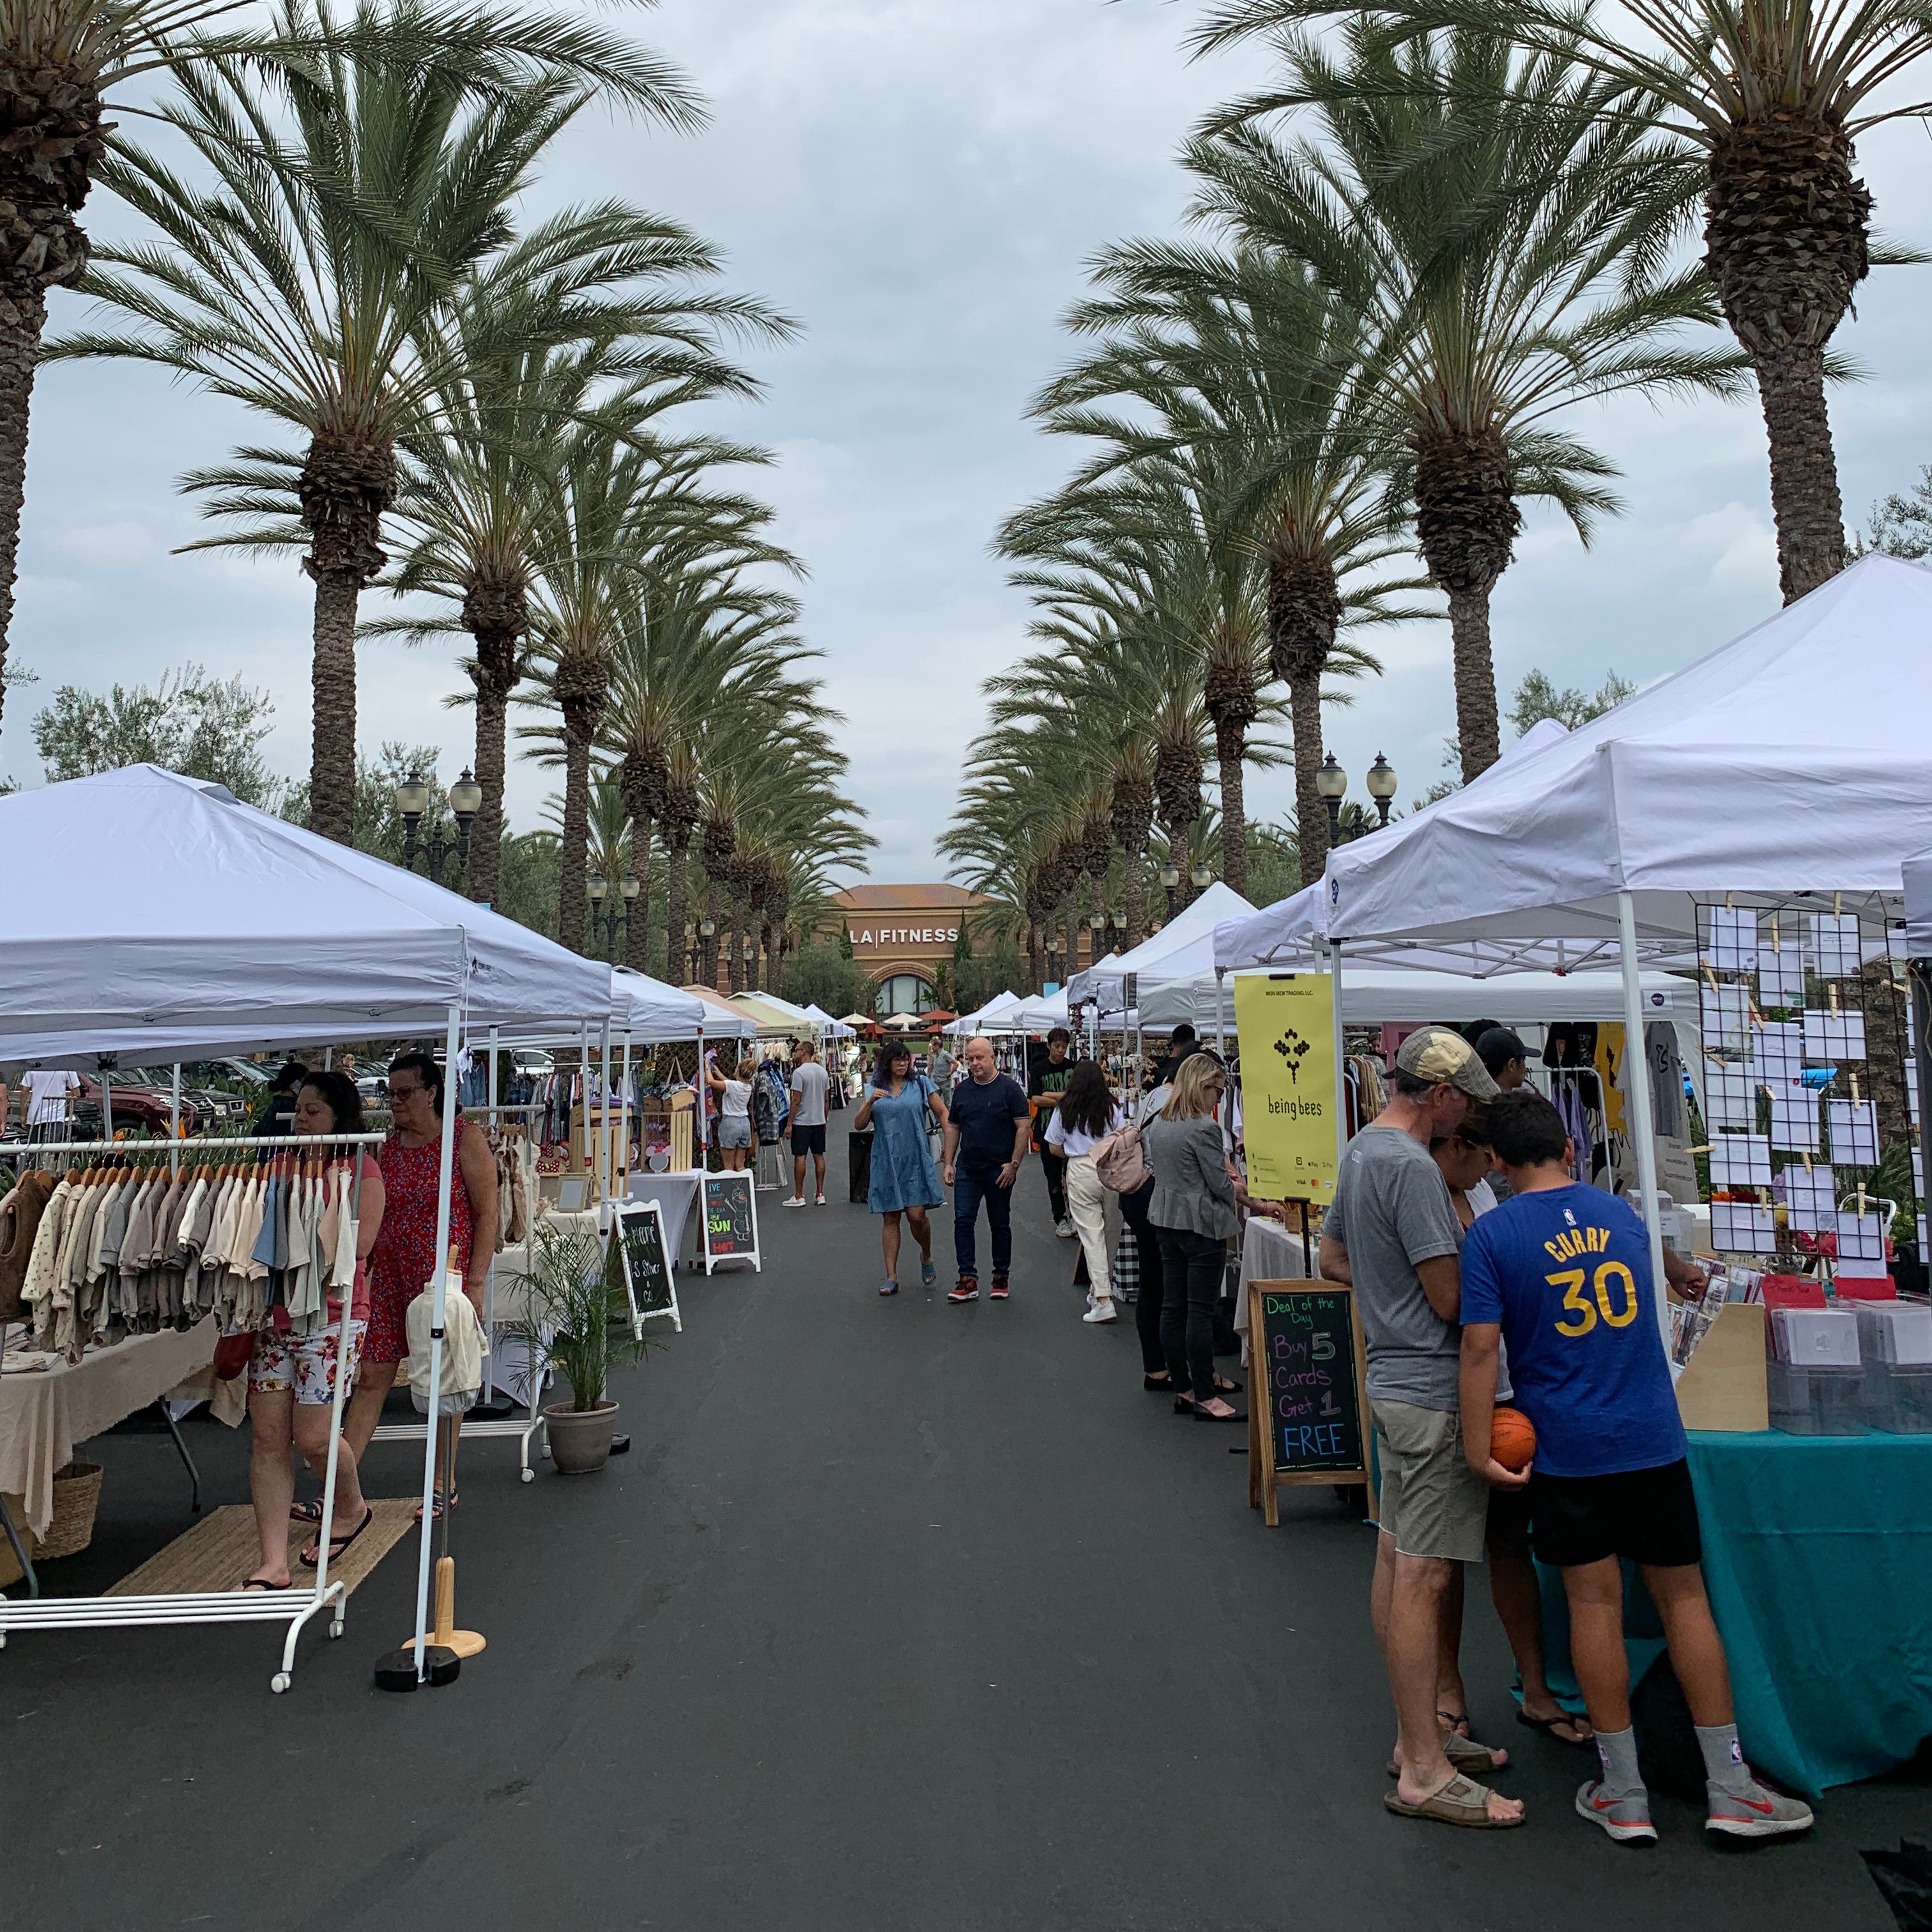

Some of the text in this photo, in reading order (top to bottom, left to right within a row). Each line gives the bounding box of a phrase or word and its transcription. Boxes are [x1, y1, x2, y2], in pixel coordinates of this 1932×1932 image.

[850, 928, 959, 944] LA FITNESS
[1268, 1094, 1322, 1121] being bees
[708, 1220, 731, 1233] SUN
[712, 1241, 735, 1254] HOT
[1544, 1227, 1611, 1263] CURRY
[1266, 1296, 1335, 1315] Deal of the
[1544, 1261, 1637, 1337] 30
[1291, 1312, 1314, 1330] Day
[1273, 1331, 1336, 1362] Buy 5
[1275, 1363, 1333, 1389] Cards
[1278, 1390, 1341, 1418] Get 1
[1284, 1423, 1346, 1459] FREE
